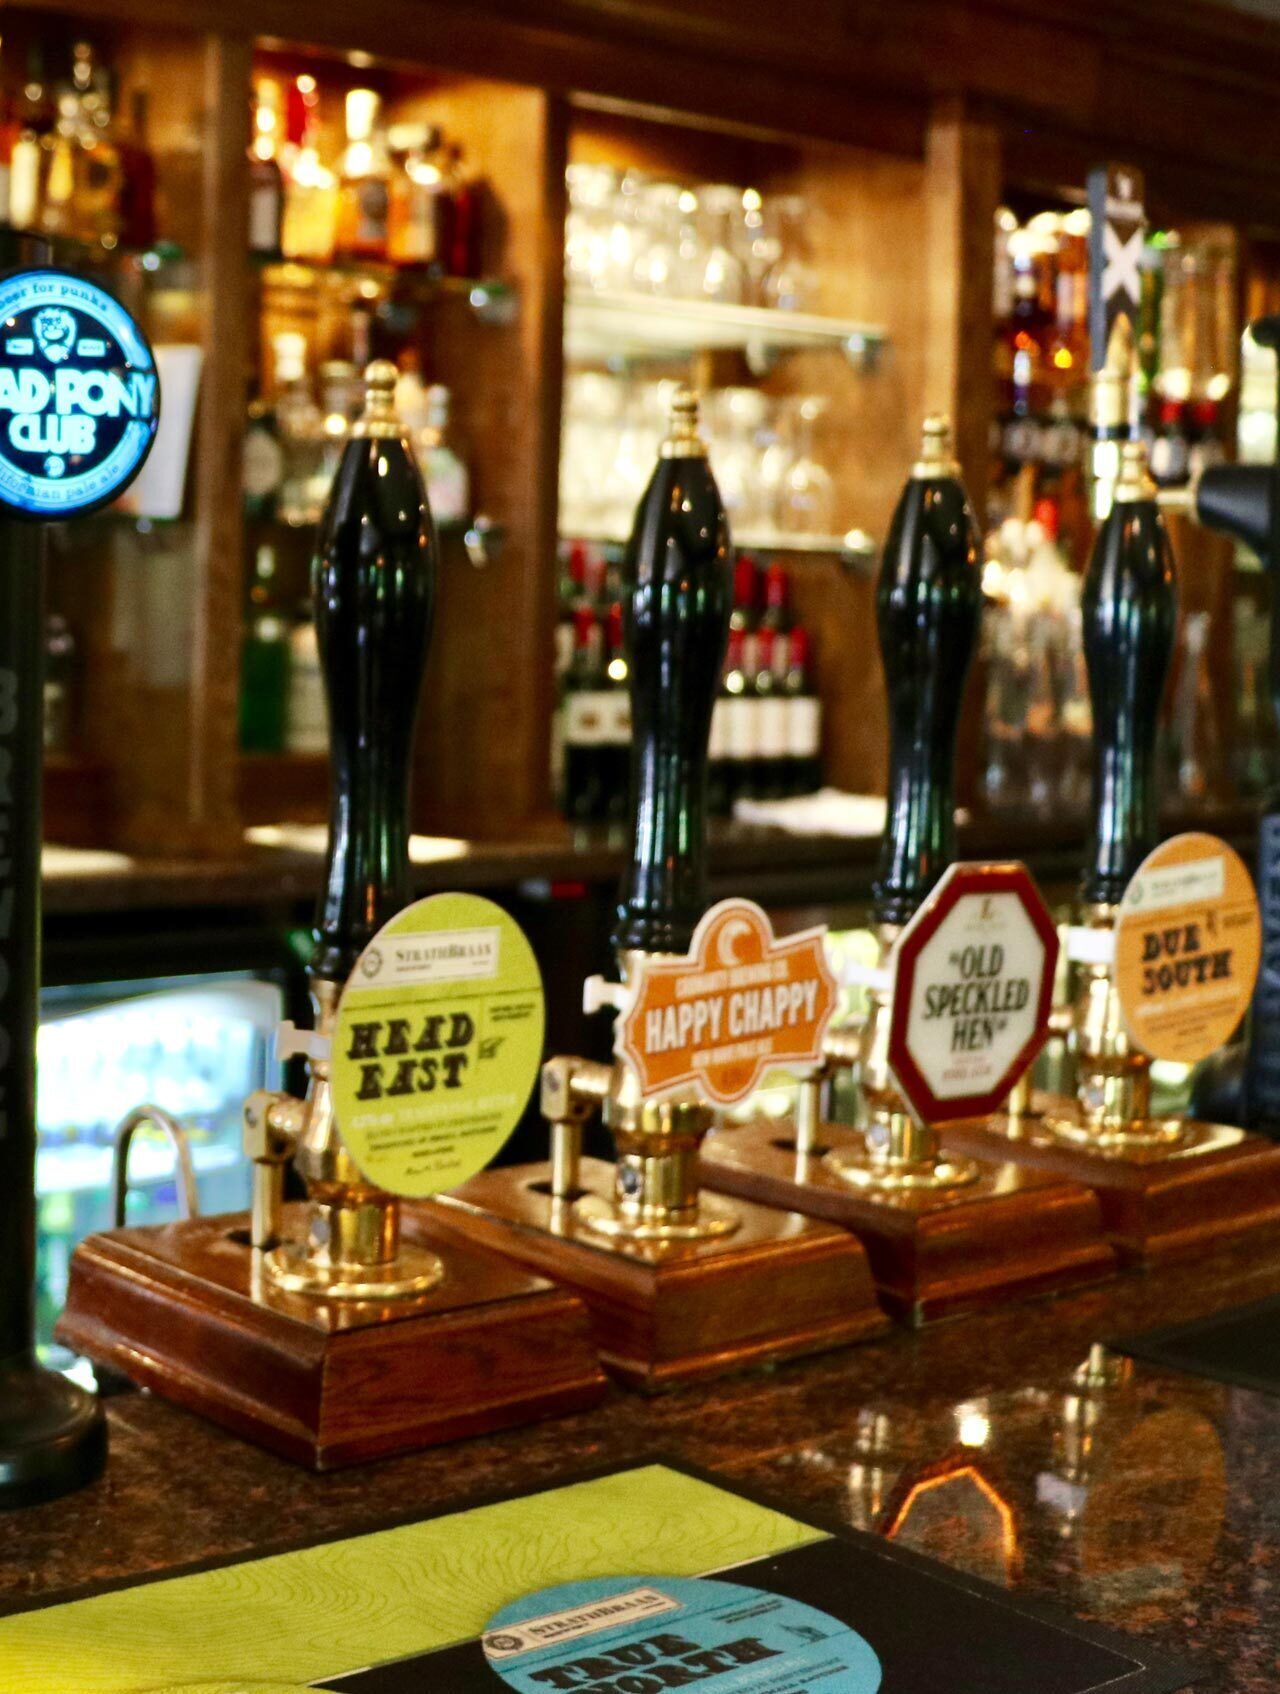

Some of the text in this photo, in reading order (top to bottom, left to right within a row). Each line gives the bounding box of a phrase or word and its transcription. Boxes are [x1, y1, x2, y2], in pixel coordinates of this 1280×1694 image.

[33, 283, 54, 296] for
[60, 284, 108, 312] punks
[54, 367, 157, 418] PONY
[8, 413, 97, 455] CLUB
[1142, 951, 1235, 995] SOUTH
[645, 994, 724, 1054] HAPPY
[727, 979, 819, 1037] CHAPPY
[923, 978, 1030, 1020] SPECKLED
[346, 1012, 475, 1060] HEAD
[355, 1052, 468, 1101] EAST
[527, 1632, 704, 1690] TRUE
